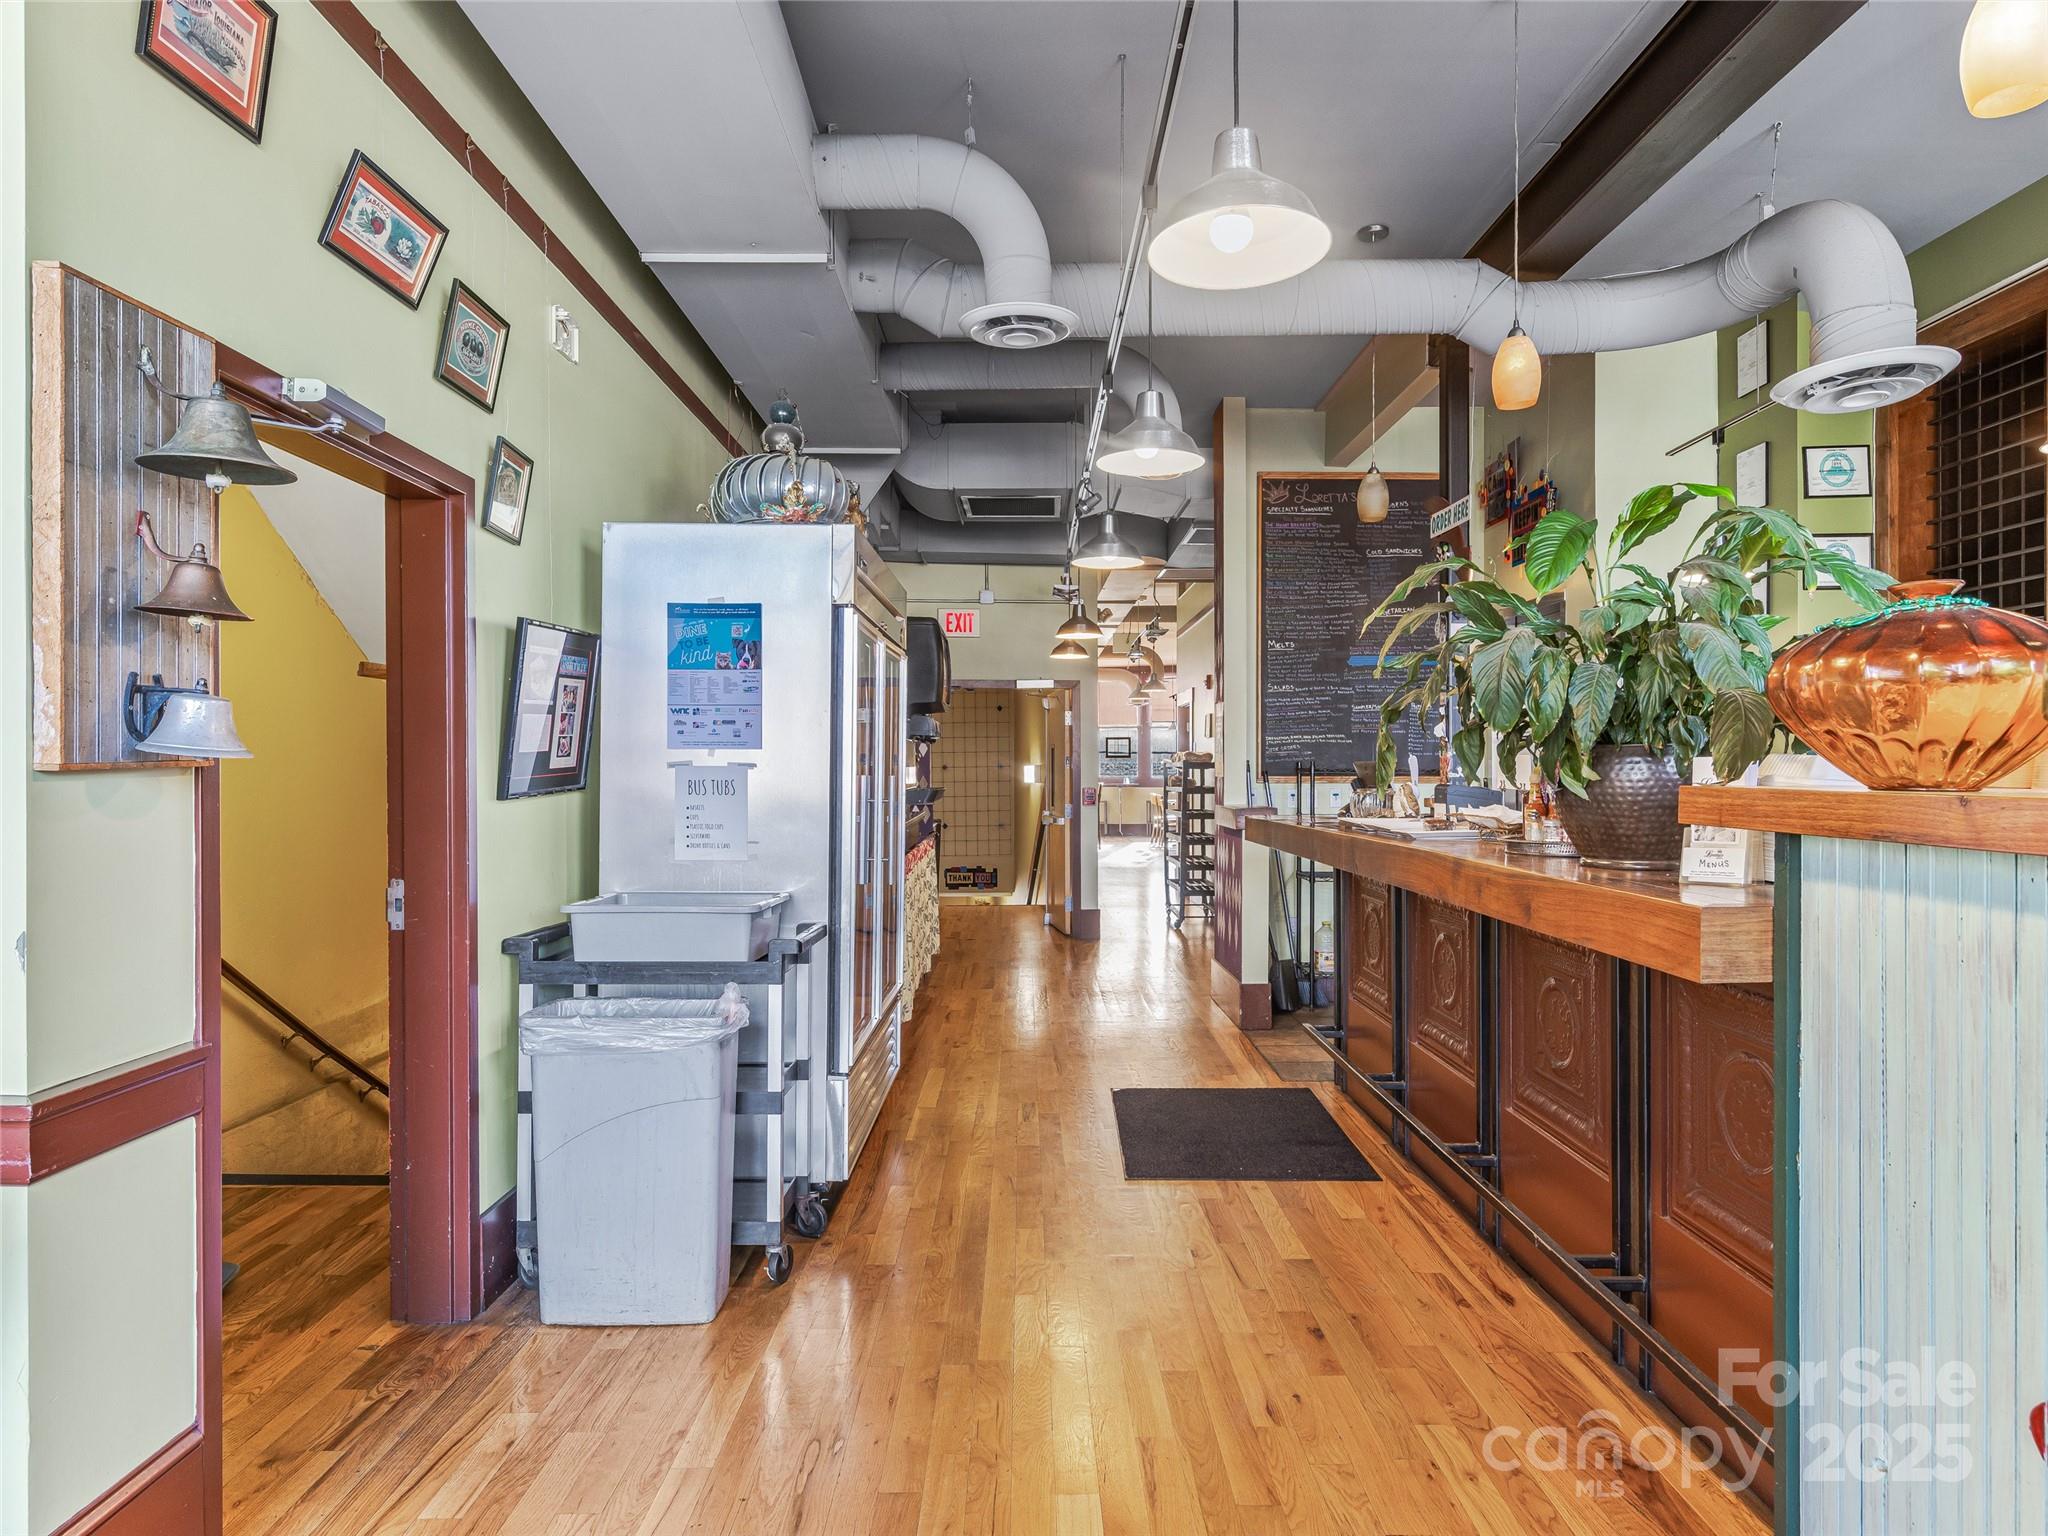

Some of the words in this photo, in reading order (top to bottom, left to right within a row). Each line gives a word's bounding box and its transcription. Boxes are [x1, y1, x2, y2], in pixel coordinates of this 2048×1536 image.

[1431, 508, 1452, 535] ORDER
[1453, 499, 1469, 524] HERE
[1366, 548, 1383, 556] COLD
[1385, 547, 1423, 555] SANDWICHES
[946, 612, 974, 632] EXIT
[675, 623, 708, 640] DINE
[679, 640, 694, 649] TO
[695, 636, 709, 646] BE
[1267, 640, 1295, 649] MELTS
[680, 645, 714, 665] kind
[687, 779, 707, 796] BUS
[711, 779, 736, 796] TUBS
[948, 874, 973, 882] THANK
[975, 873, 991, 882] YOU
